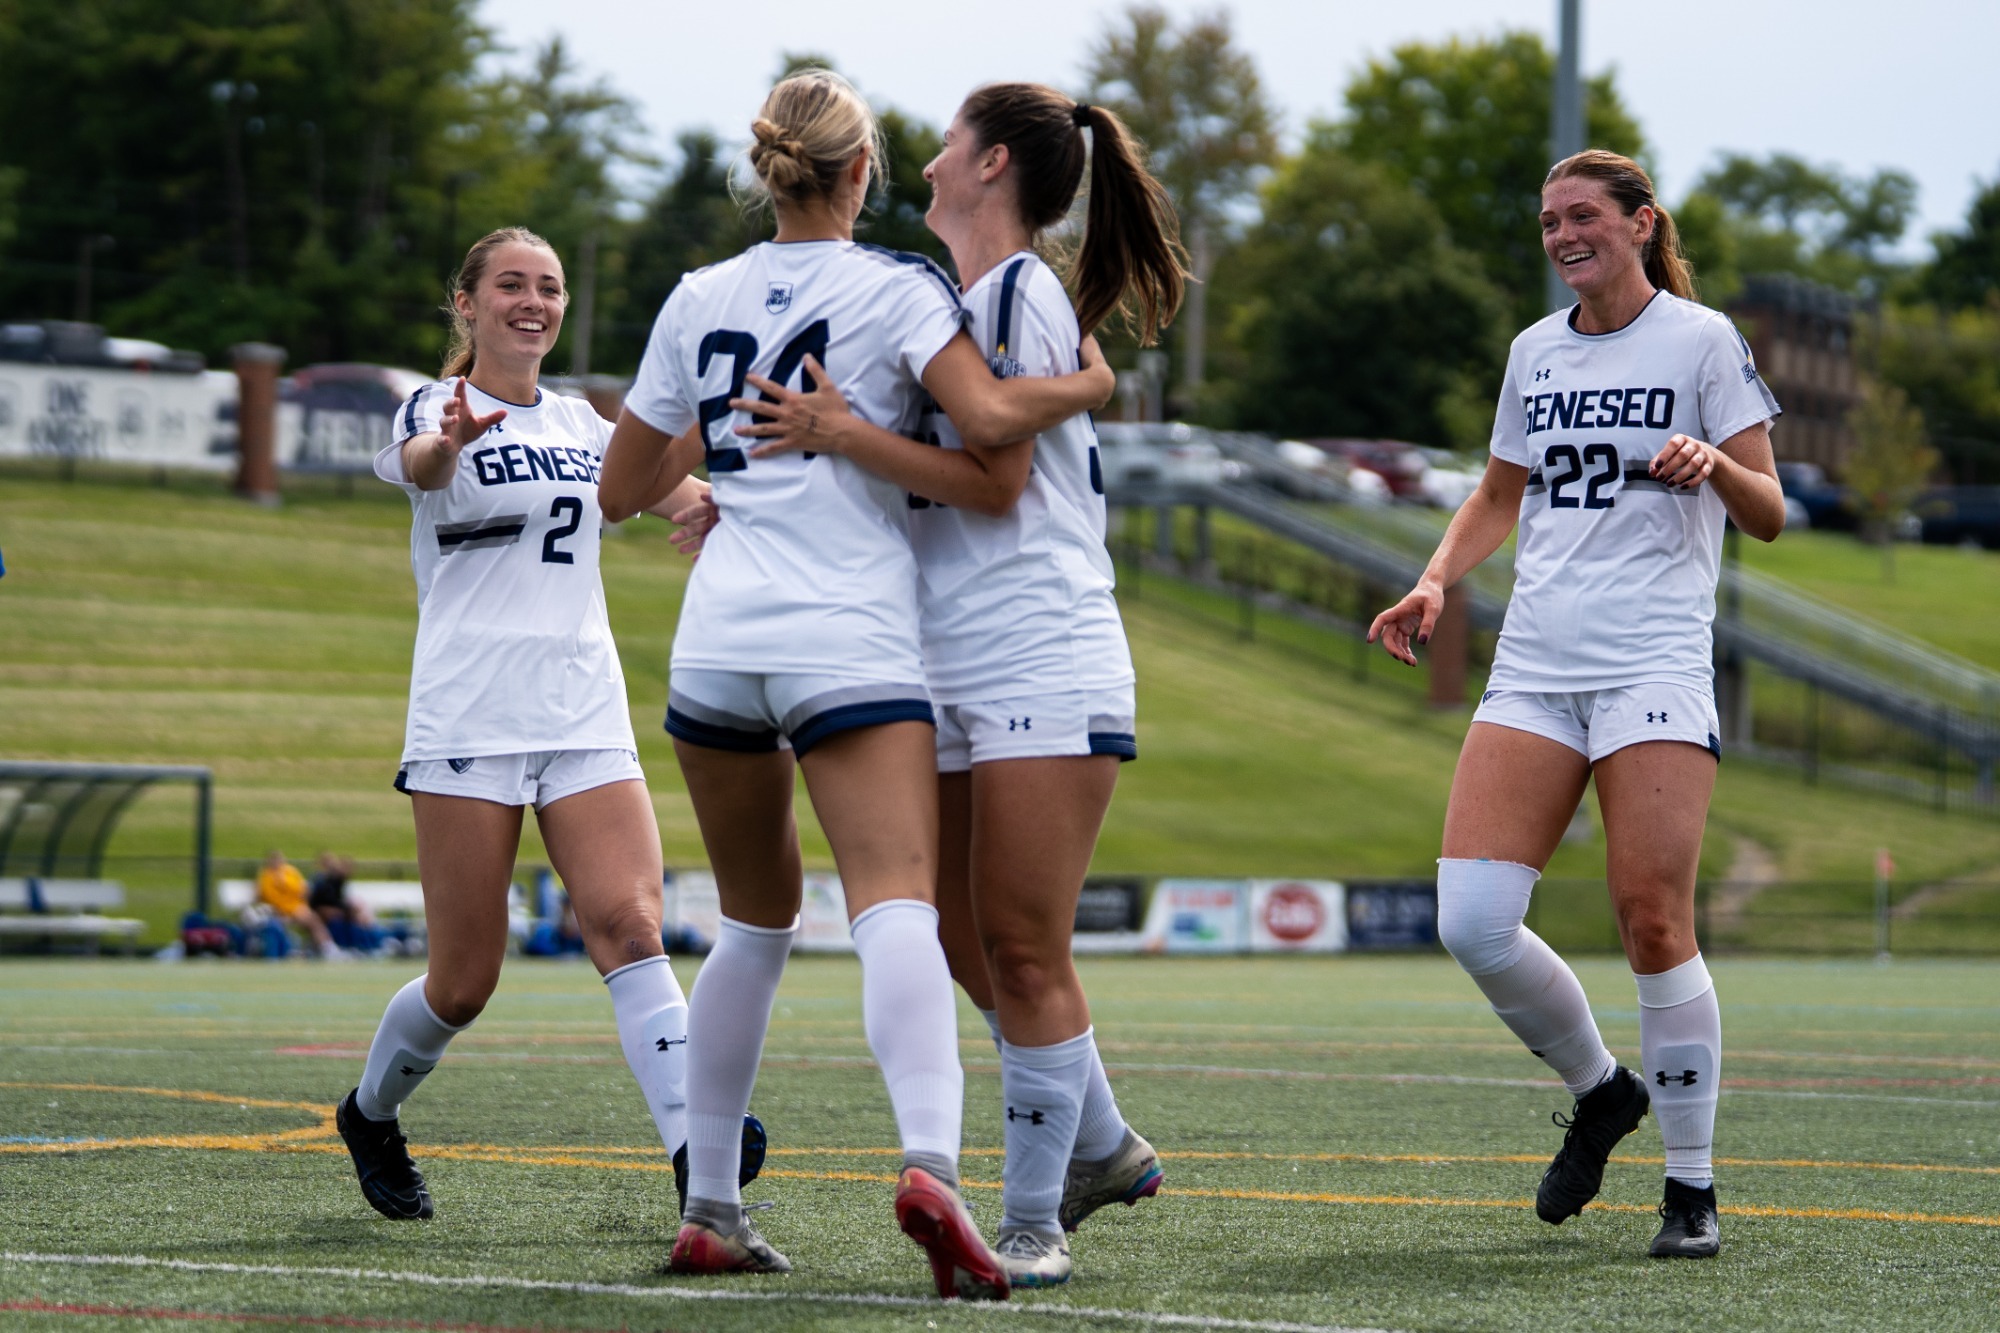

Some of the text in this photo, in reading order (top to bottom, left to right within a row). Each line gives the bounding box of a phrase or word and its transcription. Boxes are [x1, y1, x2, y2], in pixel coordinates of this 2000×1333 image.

[698, 318, 830, 472] 24
[473, 443, 601, 486] GENESE
[1545, 443, 1619, 509] 22
[542, 496, 583, 564] 2
